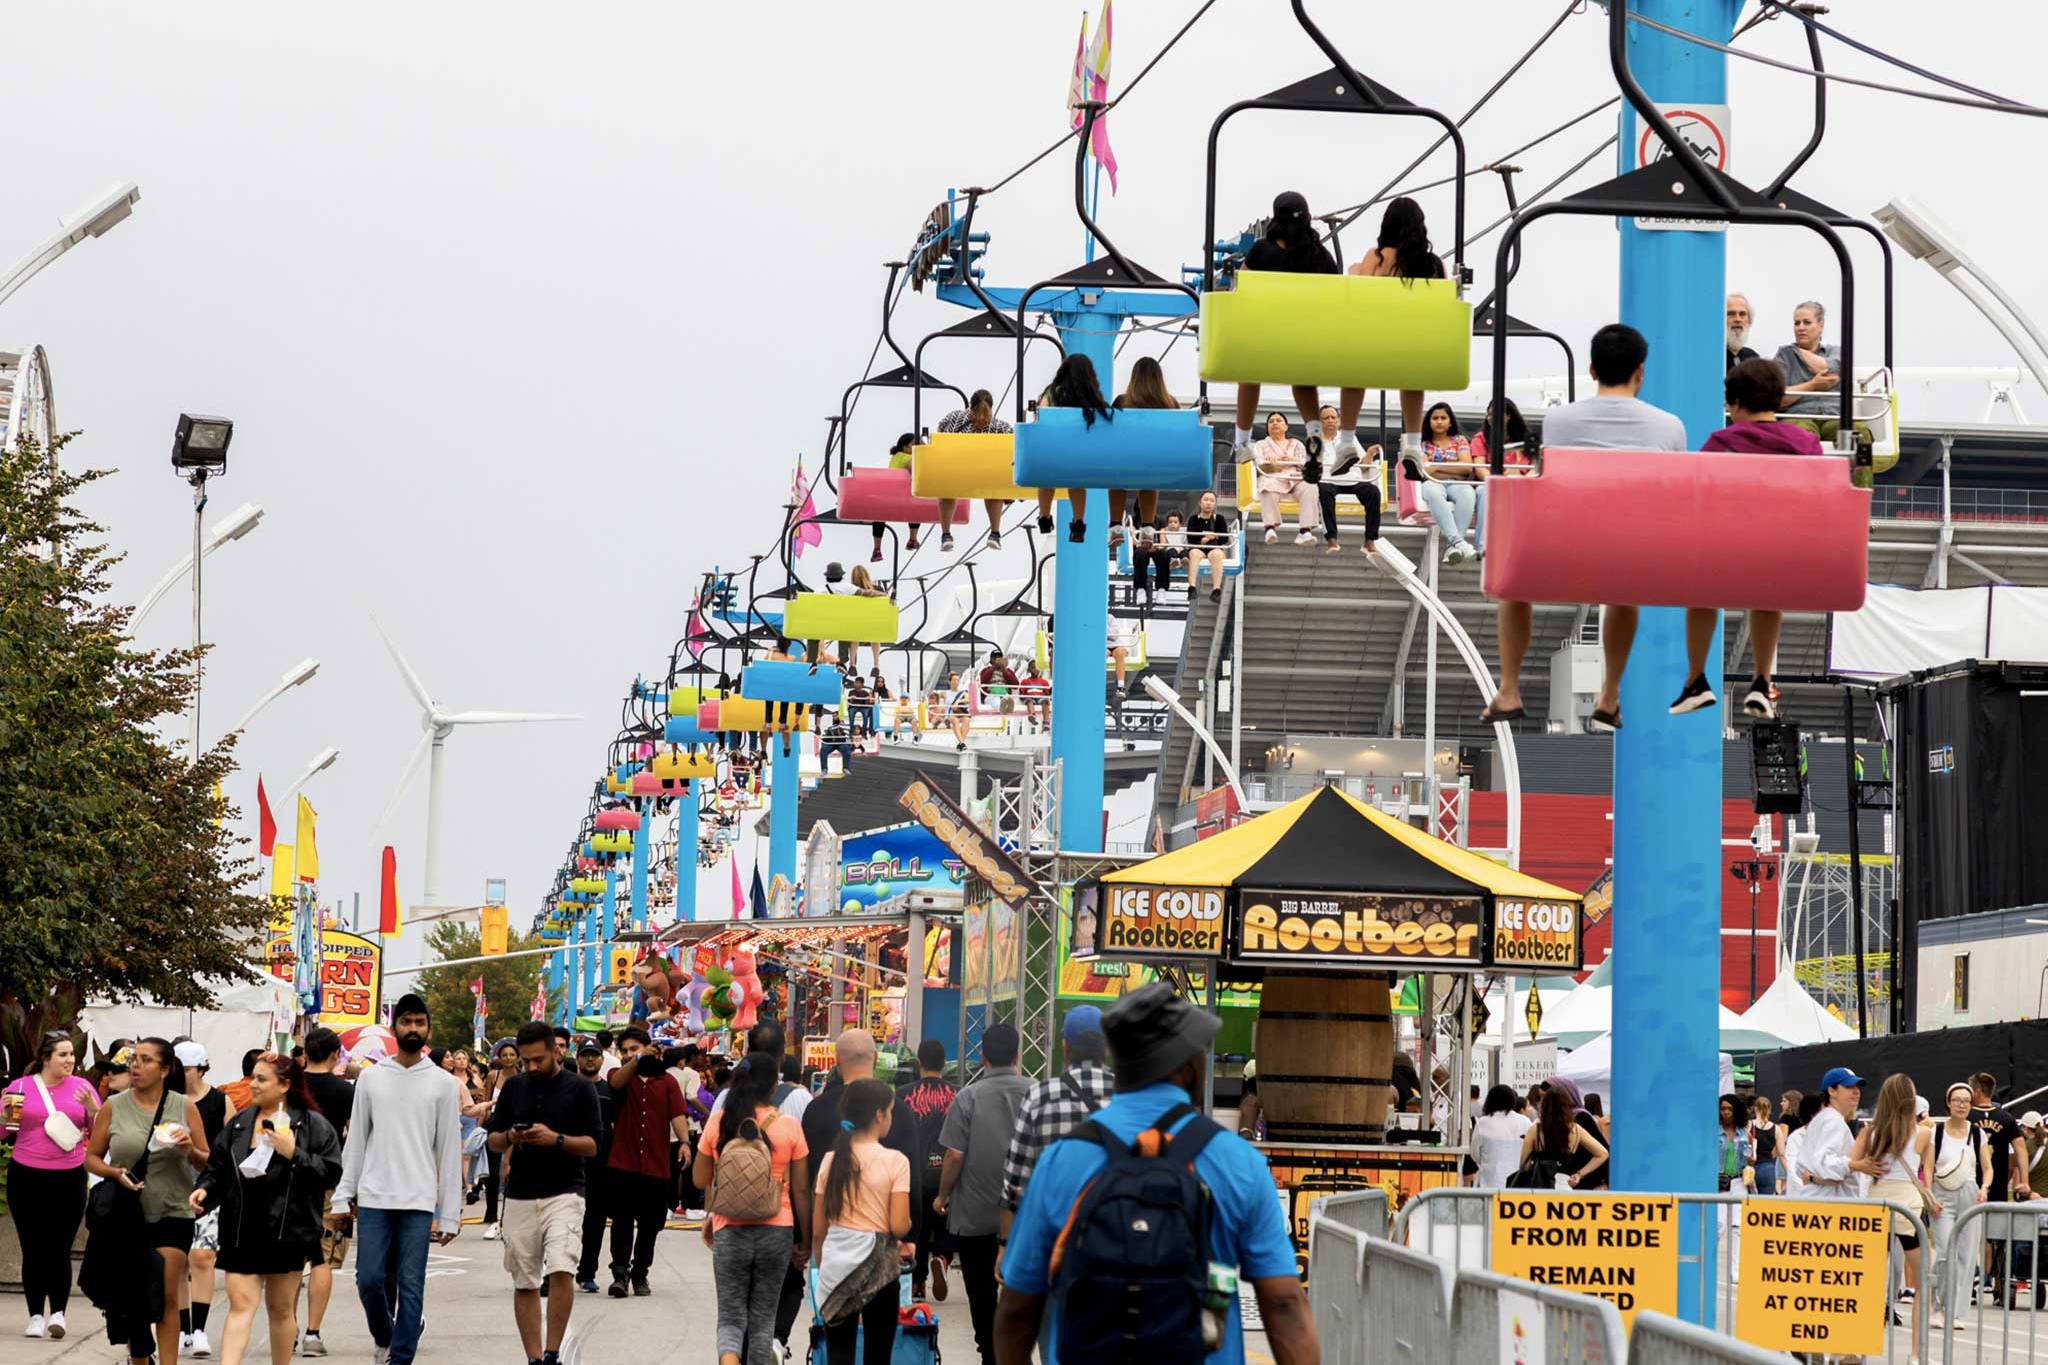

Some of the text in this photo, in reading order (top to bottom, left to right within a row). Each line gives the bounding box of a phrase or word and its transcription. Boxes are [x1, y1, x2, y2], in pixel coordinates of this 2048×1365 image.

[899, 781, 1029, 903] Rootbeer
[845, 856, 933, 886] BALL
[1113, 889, 1221, 920] ICE COLD
[1281, 900, 1341, 914] BIG BARREL
[1497, 902, 1573, 932] ICE COLD
[1110, 919, 1218, 949] Rootbeer
[1243, 904, 1478, 956] Rootbeer
[1496, 932, 1571, 961] Rootbeer
[271, 960, 373, 986] CRN
[322, 988, 370, 1015] GS
[1499, 1201, 1672, 1221] DO NOT SPIT
[1747, 1212, 1882, 1232] ONE WAY RIDE
[1511, 1227, 1660, 1247] FROM RIDE
[1763, 1240, 1864, 1259] EVERYONE
[1530, 1266, 1635, 1285] REMAIN
[1761, 1267, 1864, 1286] MUST EXIT
[1764, 1295, 1858, 1313] AT OTHER
[1791, 1323, 1829, 1340] END
